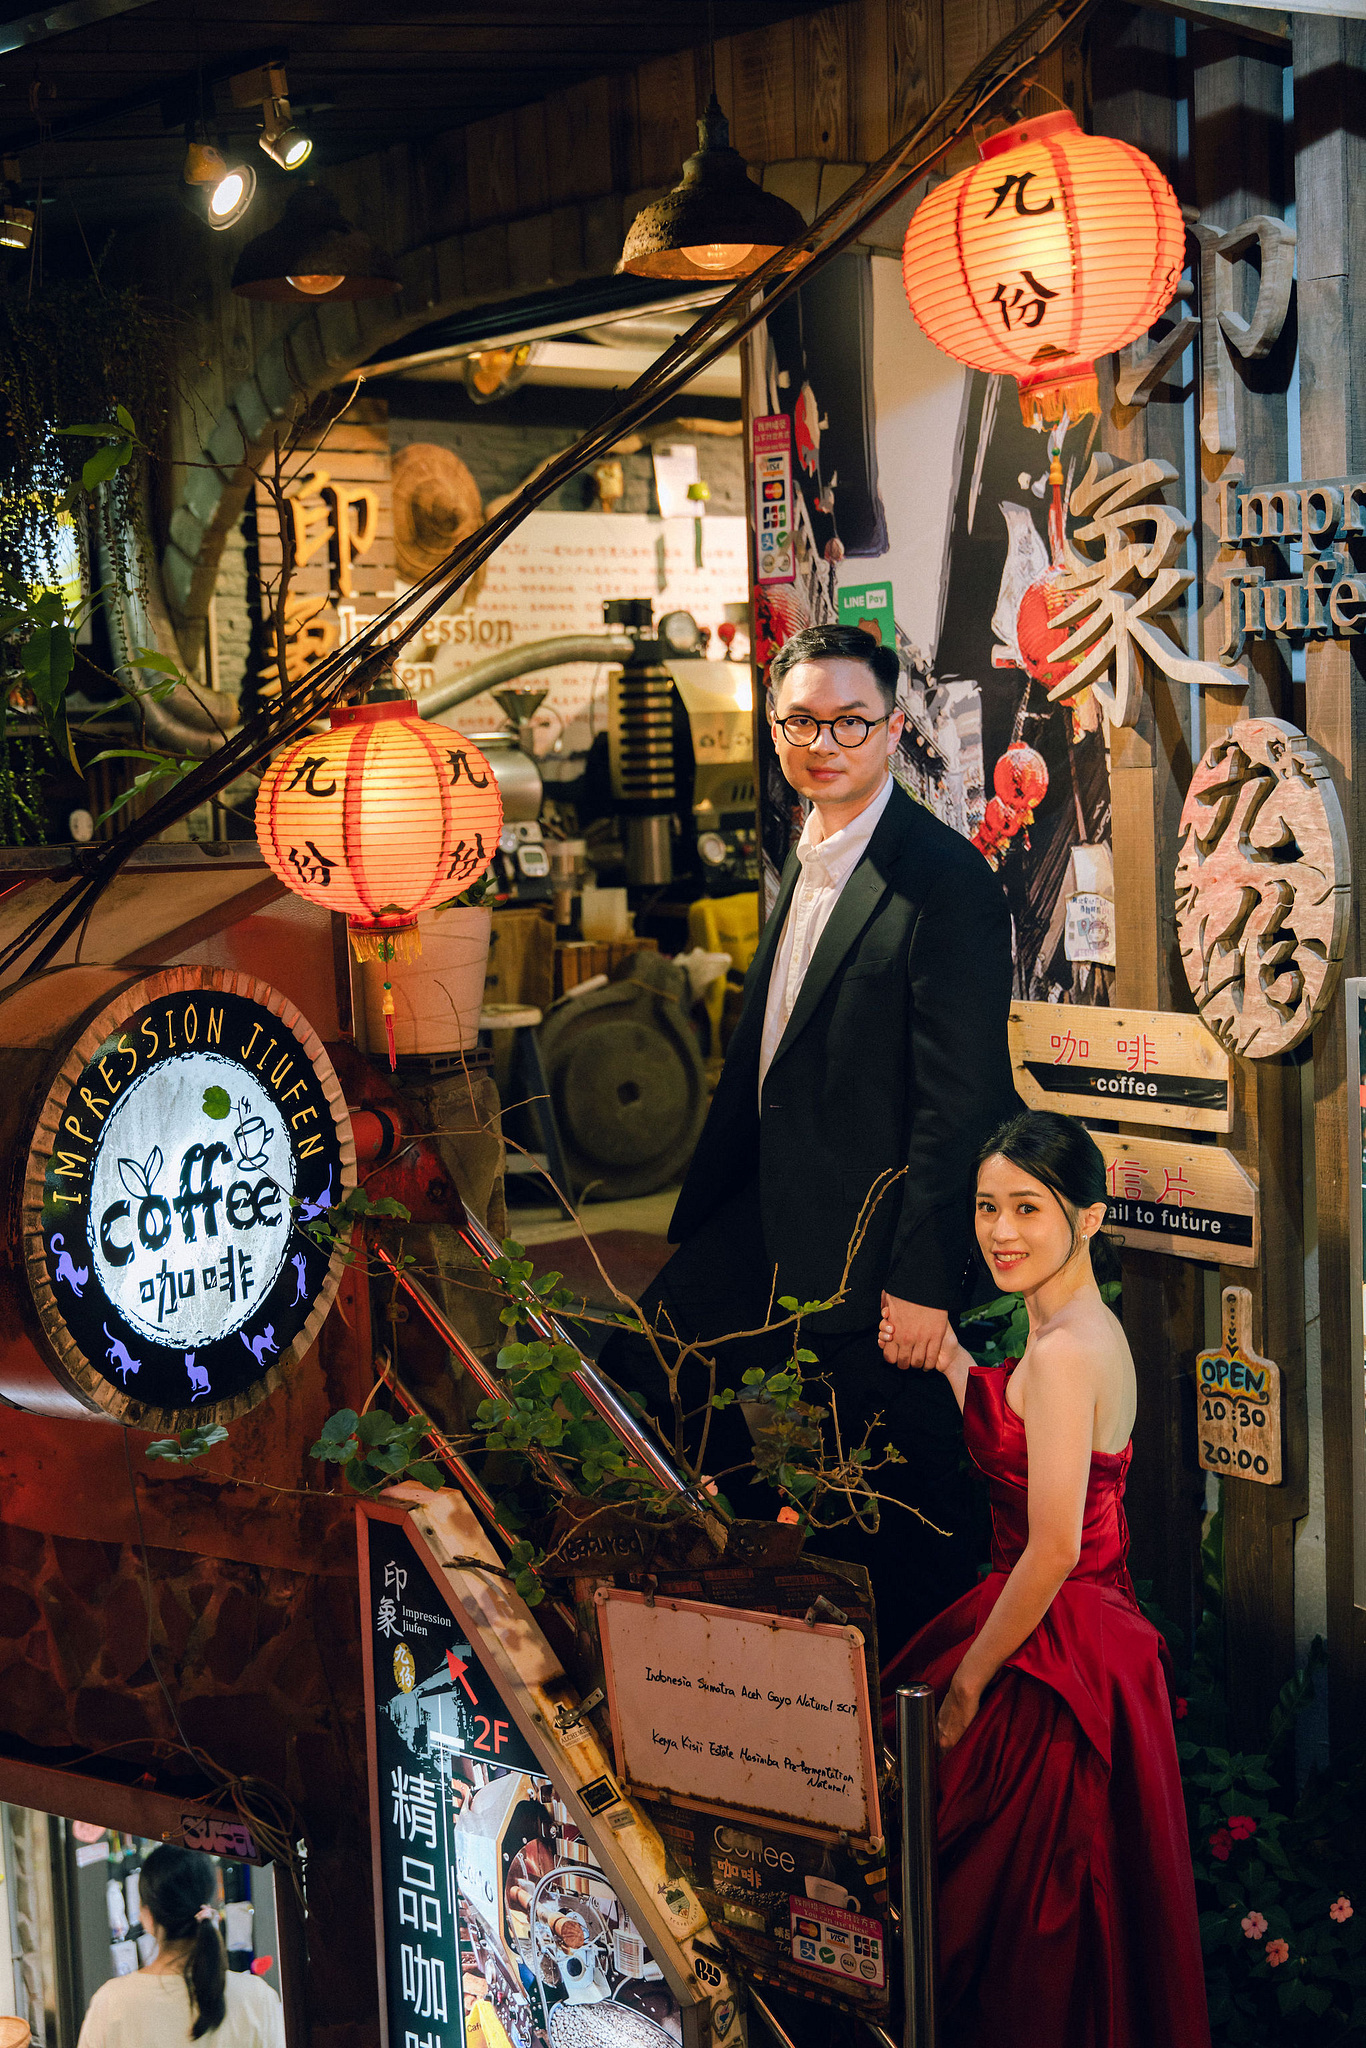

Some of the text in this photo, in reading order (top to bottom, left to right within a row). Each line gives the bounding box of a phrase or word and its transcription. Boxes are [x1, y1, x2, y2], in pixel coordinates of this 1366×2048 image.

[984, 171, 1061, 332] 九份
[843, 595, 865, 609] LINE
[284, 756, 340, 887] 九份
[445, 749, 489, 881] 九份
[52, 1003, 325, 1204] IMPRESSION JIUFEN
[1096, 1075, 1158, 1097] coffee
[1106, 1158, 1196, 1208] 信片
[1108, 1203, 1222, 1234] ail to future
[138, 1244, 255, 1323] 咖啡
[1201, 1359, 1265, 1393] OPEN
[1202, 1400, 1266, 1428] 10:30
[1202, 1440, 1269, 1476] 20:00
[377, 1560, 408, 1639] 印象
[402, 1605, 452, 1628] Impression
[402, 1619, 428, 1637] Jiufen
[645, 1667, 693, 1690] Indonesia
[741, 1685, 763, 1701] Aceh
[795, 1693, 834, 1712] Natural
[473, 1714, 509, 1755] 2F
[652, 1728, 679, 1755] Kenya
[391, 1765, 448, 2048] 精品咖
[830, 1933, 846, 1944] VISA
